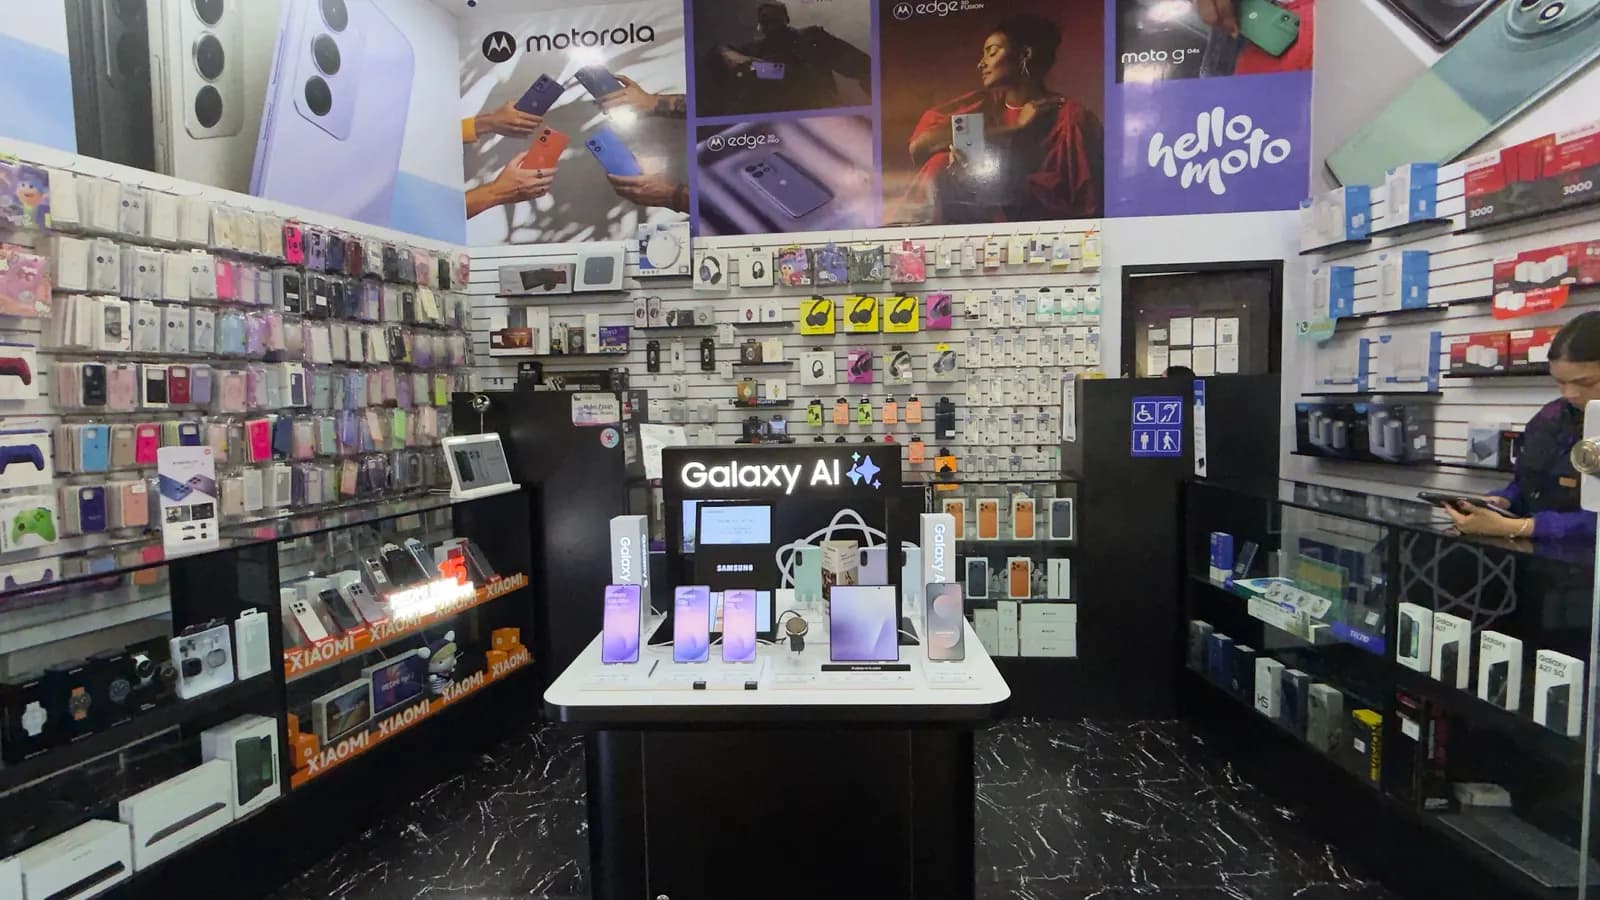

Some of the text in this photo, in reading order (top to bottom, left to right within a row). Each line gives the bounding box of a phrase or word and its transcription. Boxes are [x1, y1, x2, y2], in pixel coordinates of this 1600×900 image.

[916, 0, 958, 16] edge
[526, 23, 655, 53] motorola
[1121, 49, 1168, 64] moto
[1172, 49, 1185, 64] g
[727, 134, 766, 149] edge
[1148, 106, 1252, 177] hello
[1180, 128, 1291, 195] moto
[1562, 180, 1593, 195] 3000
[1469, 205, 1494, 218] 3000
[681, 458, 840, 495] Galaxy AI
[619, 536, 632, 581] Galaxy
[931, 523, 946, 571] Galaxy
[716, 564, 754, 573] SAMSUNG
[486, 573, 522, 598] XIAOMI
[369, 616, 423, 643] XIAOMI
[290, 637, 355, 673] XIAOMI
[491, 650, 528, 678] XIAOMI
[1539, 654, 1567, 670] Galaxy
[441, 670, 484, 704] XIAOMI
[379, 700, 430, 738] XIAOMI
[307, 729, 369, 777] XIAOMI
